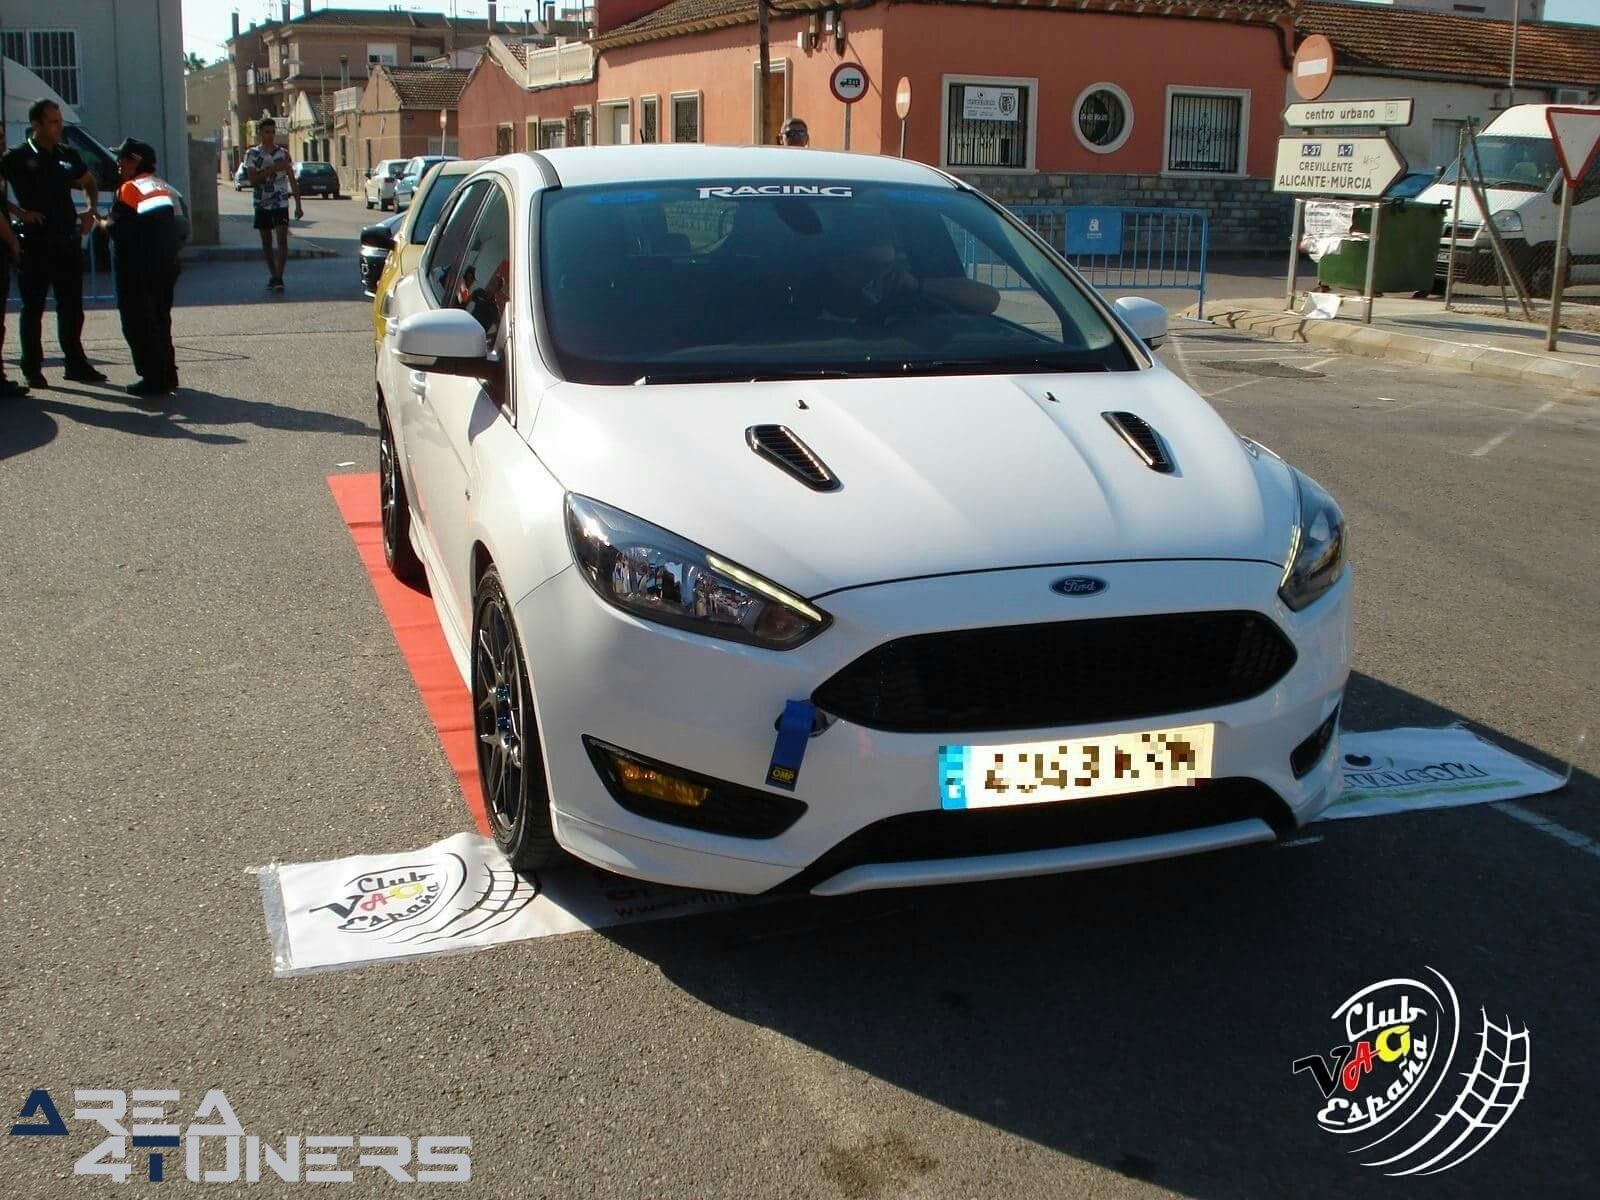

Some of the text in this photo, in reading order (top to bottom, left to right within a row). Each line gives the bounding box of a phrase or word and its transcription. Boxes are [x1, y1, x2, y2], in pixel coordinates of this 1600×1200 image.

[1305, 107, 1375, 120] centro urbano
[1338, 144, 1353, 156] A-7
[1299, 161, 1353, 172] CREVILLENTE
[696, 185, 853, 199] RACING
[1063, 578, 1097, 593] Ford
[772, 767, 795, 781] OMP
[357, 872, 435, 894] Club
